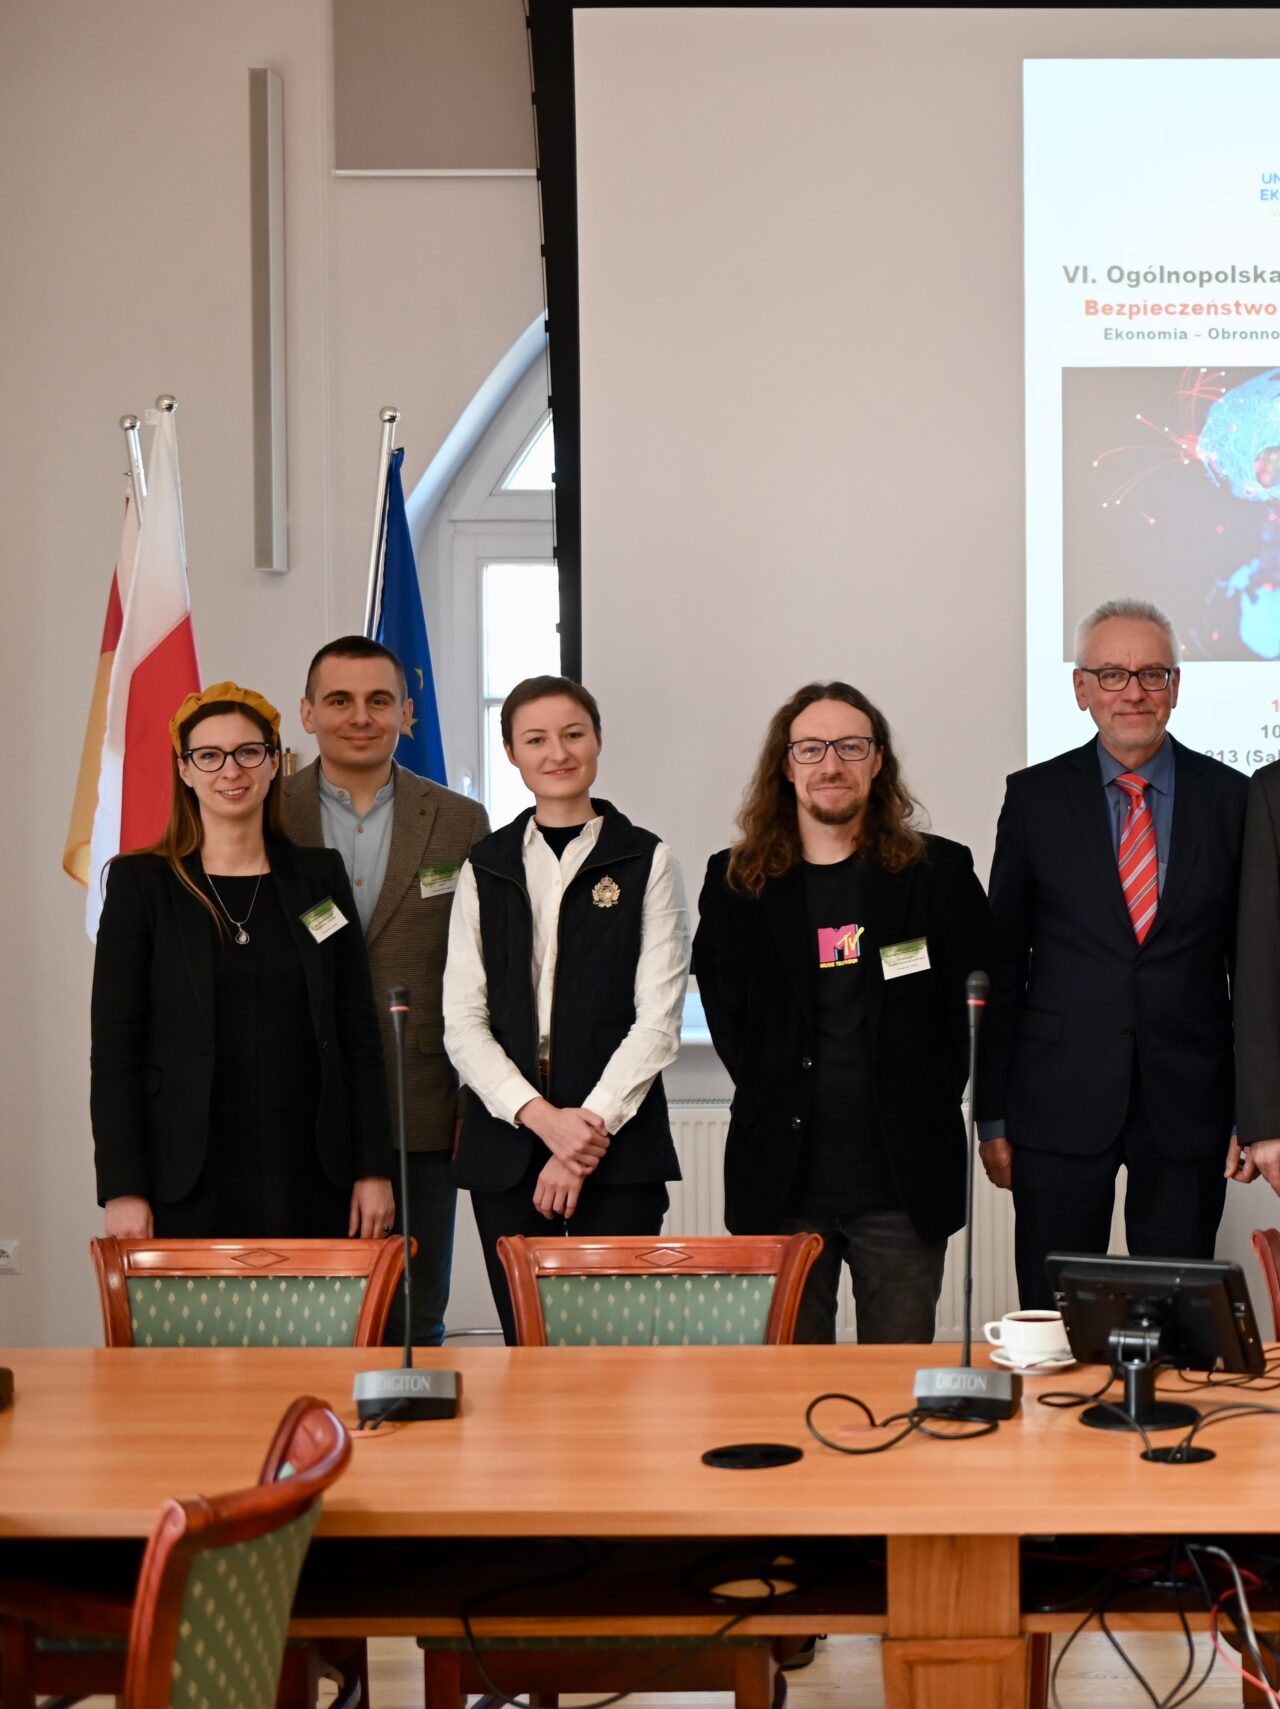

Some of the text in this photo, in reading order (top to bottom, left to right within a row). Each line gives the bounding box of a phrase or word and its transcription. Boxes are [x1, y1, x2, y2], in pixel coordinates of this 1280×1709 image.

[1062, 265, 1097, 284] VI.
[1084, 298, 1277, 320] Bezpieczeństwo
[1103, 327, 1188, 340] Ekonomia
[817, 923, 865, 963] MTV
[377, 1374, 432, 1392] DIGITON
[935, 1372, 988, 1392] DIGITON
